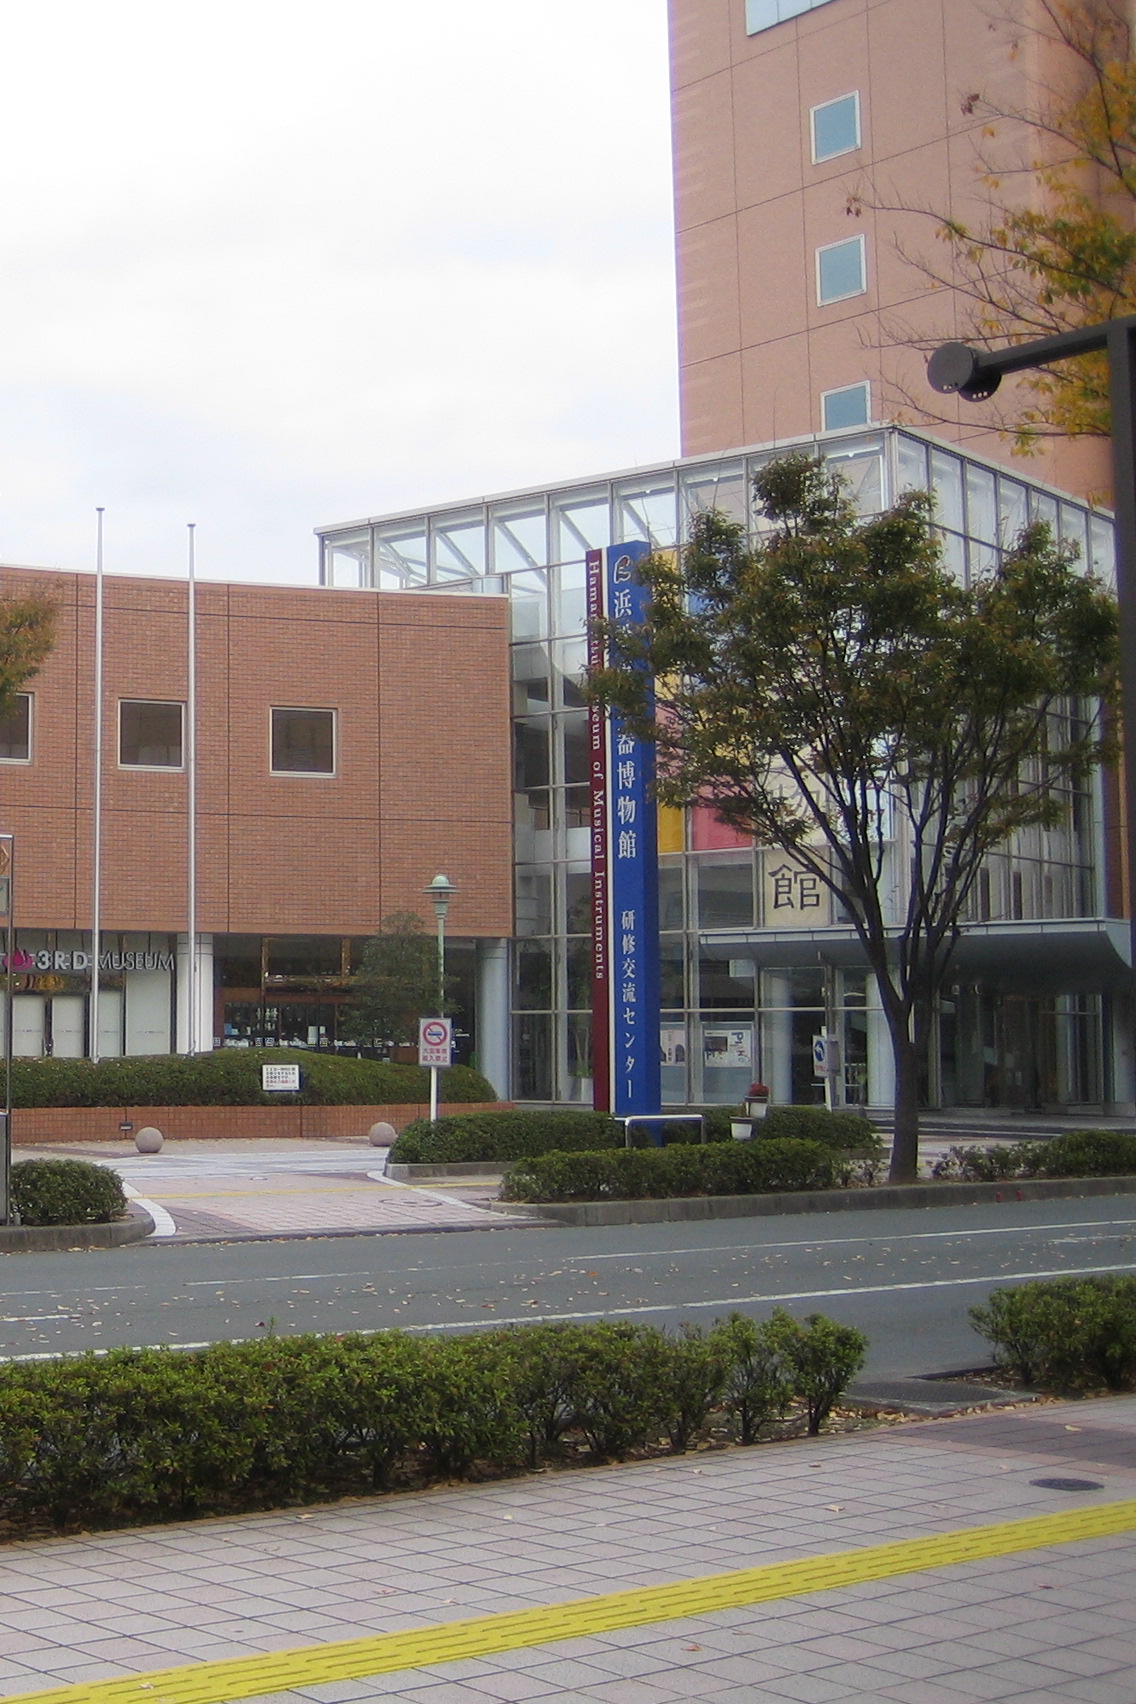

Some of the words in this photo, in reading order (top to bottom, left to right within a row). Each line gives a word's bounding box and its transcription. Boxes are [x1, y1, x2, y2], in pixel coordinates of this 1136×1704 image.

[592, 761, 604, 780] of
[593, 791, 605, 859] Musical
[768, 863, 822, 910] 館
[594, 871, 605, 979] Instruments
[36, 949, 87, 970] 3RD
[97, 950, 175, 971] MUSEUM
[620, 909, 637, 1098] 研修交流センター
